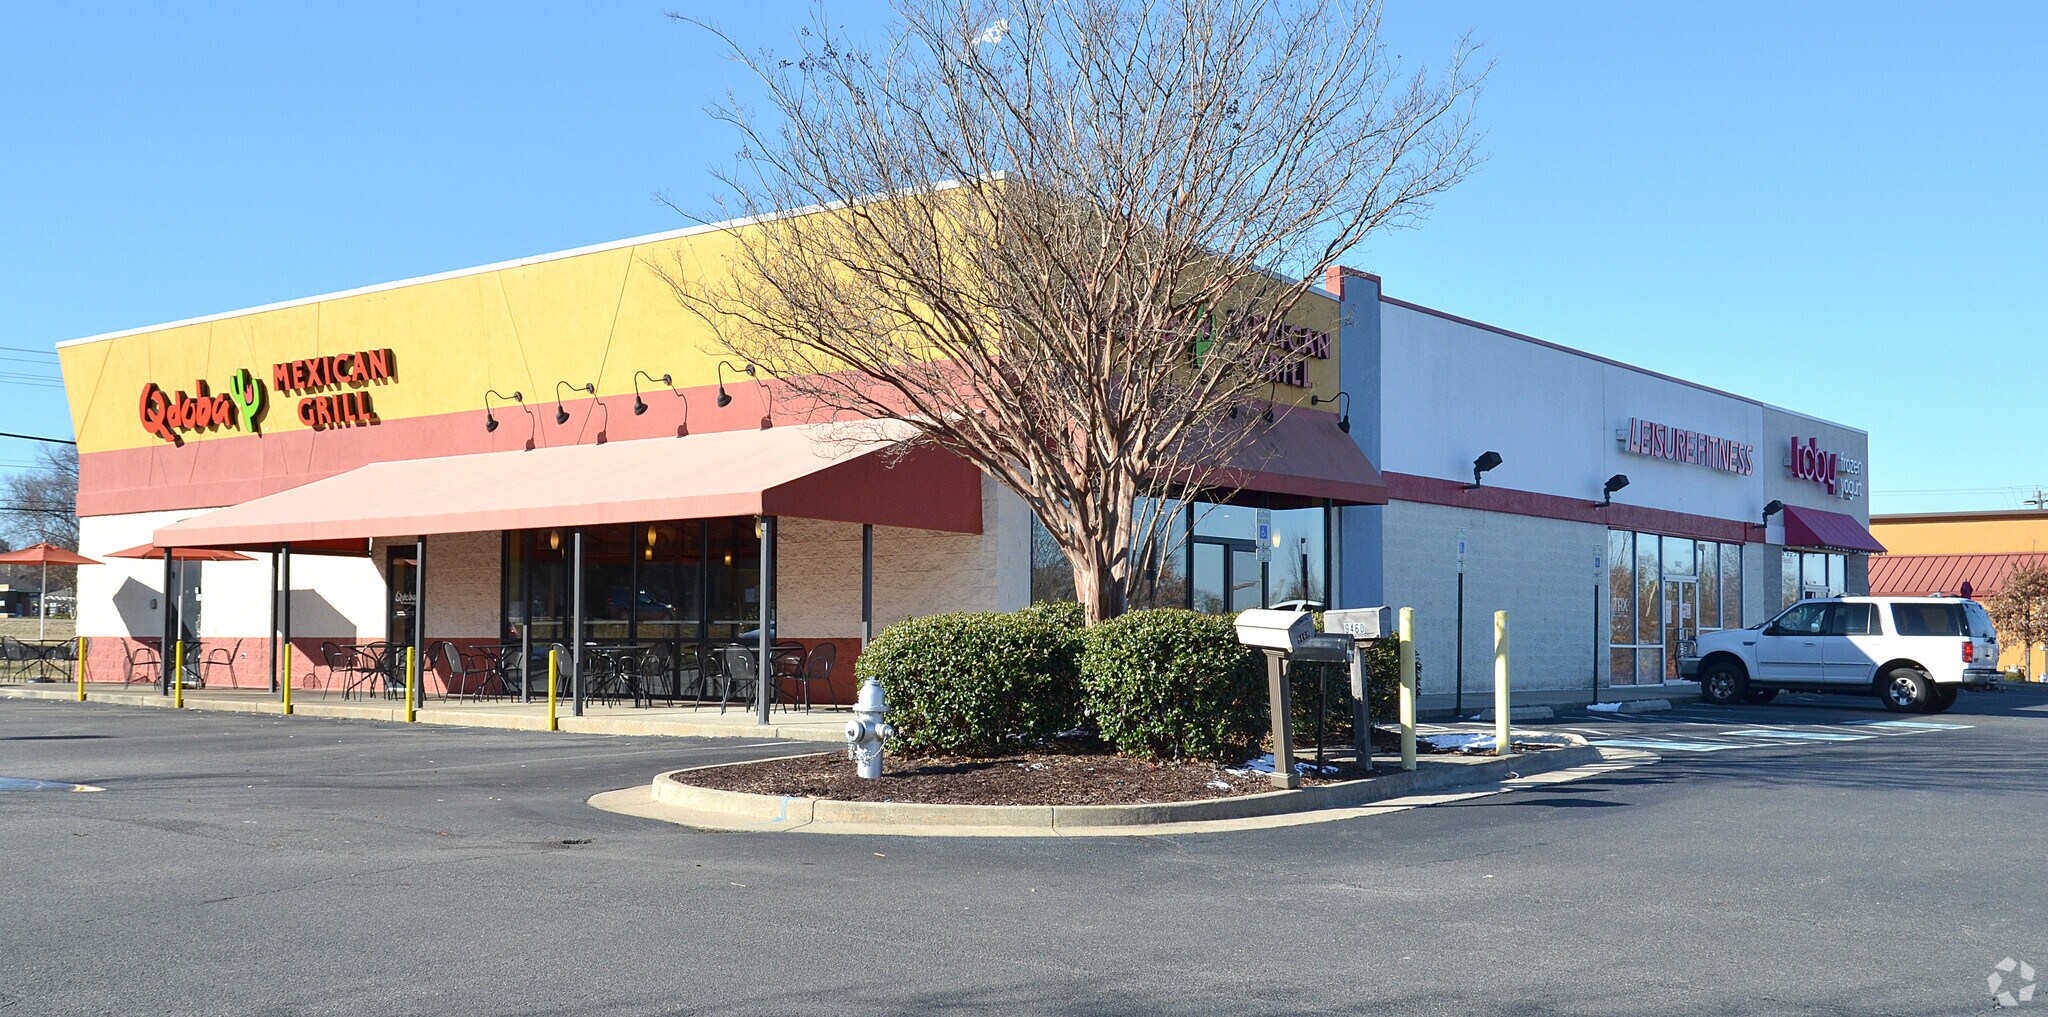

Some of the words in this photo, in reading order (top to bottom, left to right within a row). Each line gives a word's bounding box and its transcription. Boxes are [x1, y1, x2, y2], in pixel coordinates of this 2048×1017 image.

[1231, 311, 1330, 359] XICAN
[273, 348, 390, 391] MEXICAN
[140, 379, 230, 443] Qdoba
[297, 391, 371, 427] GRILL
[1629, 417, 1696, 464] LEISURE
[1697, 433, 1753, 476] FITNESS
[1840, 452, 1862, 475] frozen
[1840, 477, 1862, 500] yogurt
[1344, 623, 1365, 634] 9460
